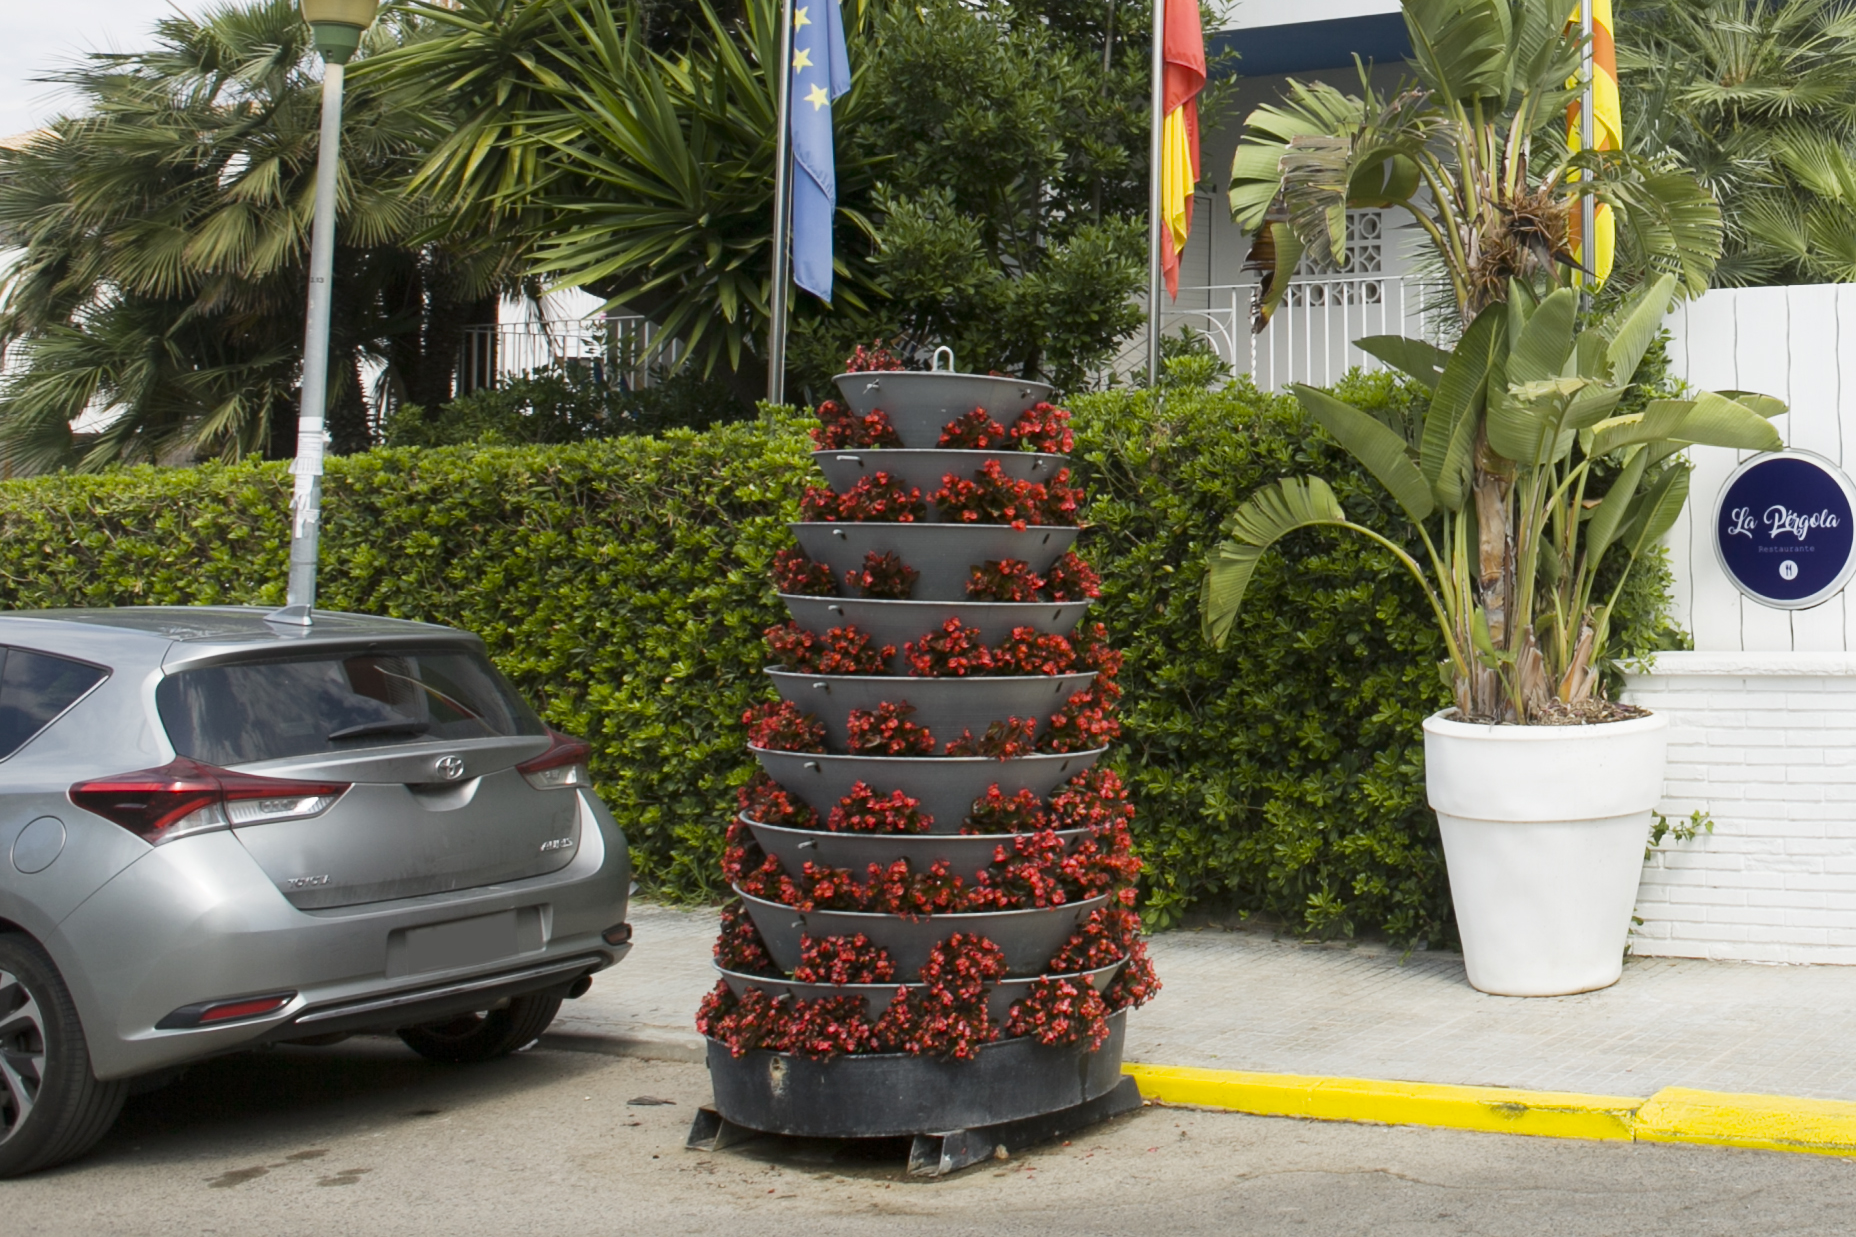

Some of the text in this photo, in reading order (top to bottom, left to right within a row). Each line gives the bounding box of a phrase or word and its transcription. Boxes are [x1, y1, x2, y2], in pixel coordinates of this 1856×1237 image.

[1728, 505, 1841, 541] La Pérgola
[1758, 545, 1816, 553] Restaurante
